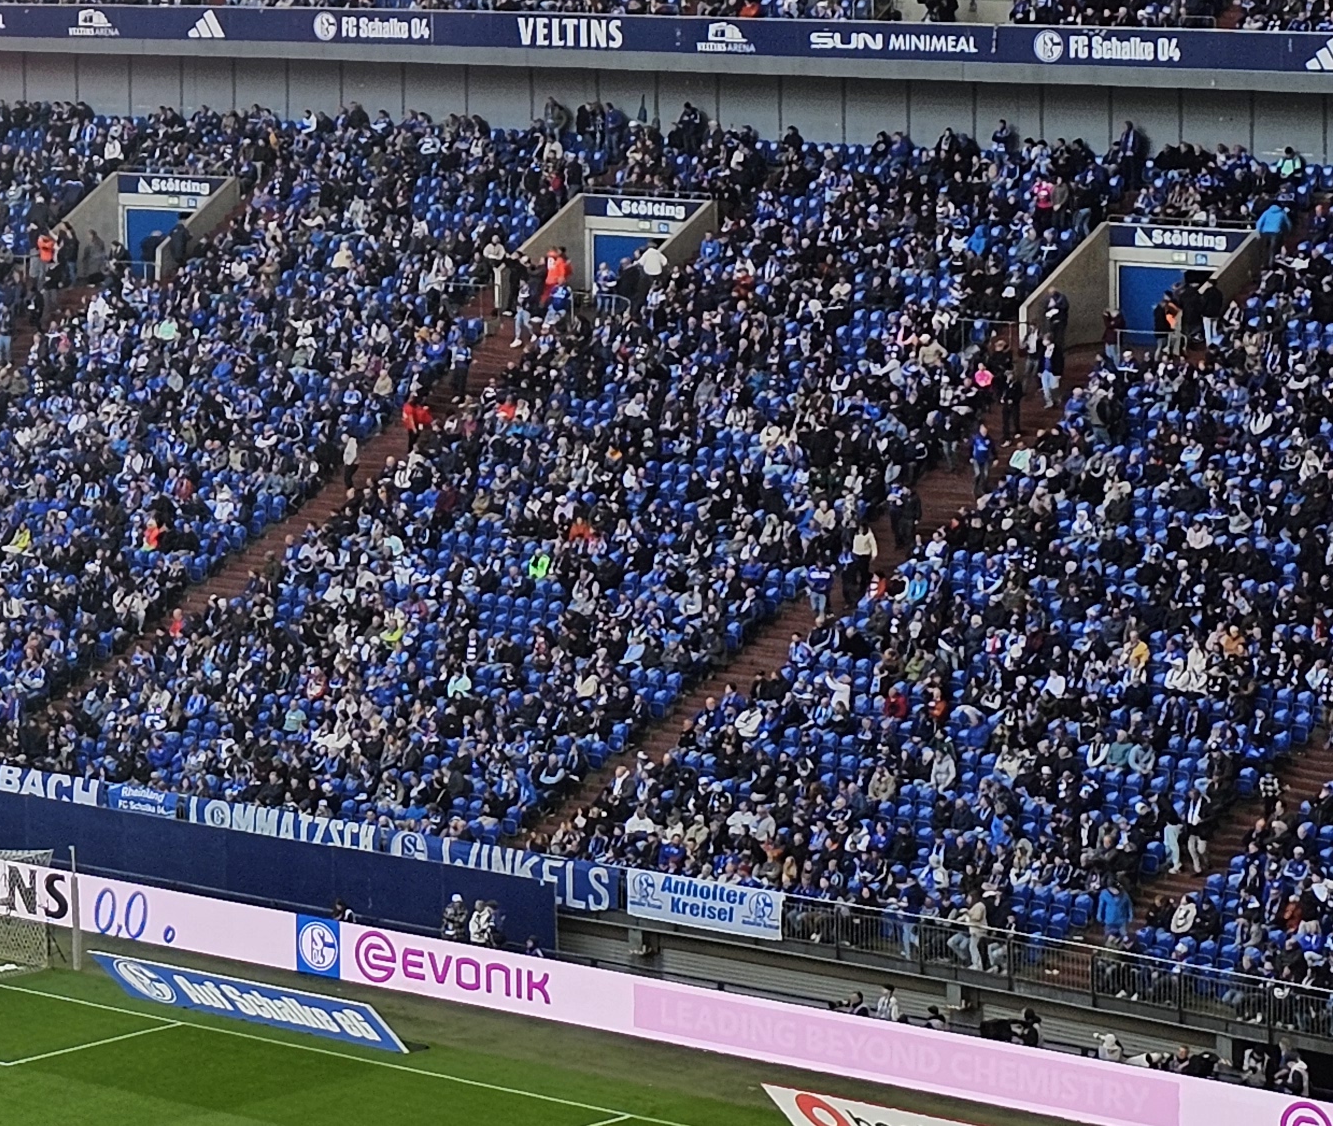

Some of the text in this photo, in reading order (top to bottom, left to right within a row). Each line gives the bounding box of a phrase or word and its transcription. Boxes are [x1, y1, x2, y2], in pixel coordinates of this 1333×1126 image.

[341, 17, 430, 39] FC Schalke 04
[518, 17, 624, 48] VELTINS
[810, 31, 978, 54] SUN MINIMEAL
[1069, 35, 1180, 61] FC Schalke 04
[151, 177, 210, 196] Stölting
[621, 200, 685, 219] Stölting
[1152, 229, 1227, 250] Stölting
[442, 837, 609, 911] WINKELS
[661, 876, 747, 905] Anholter
[671, 897, 734, 922] Kreisel
[173, 974, 381, 1042] Auf Schalke eG
[661, 996, 1151, 1112] LEADING BEYOND CHEMISTRY
